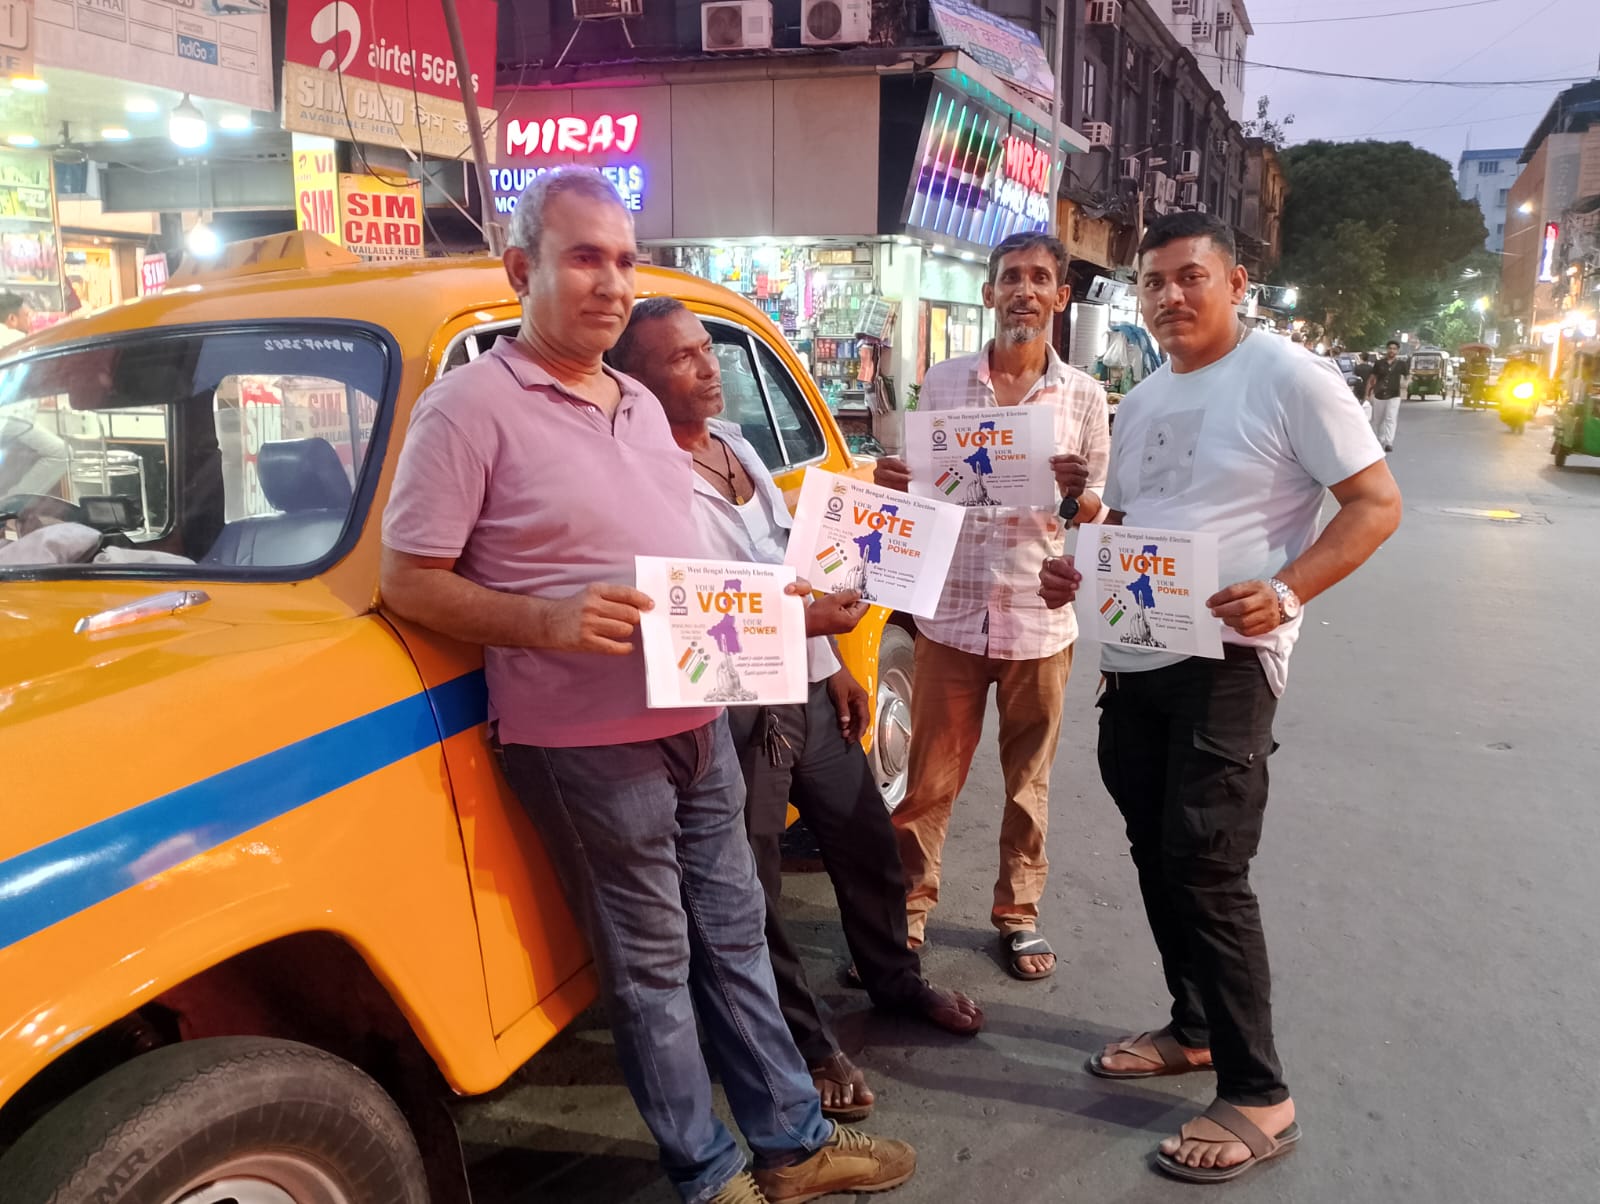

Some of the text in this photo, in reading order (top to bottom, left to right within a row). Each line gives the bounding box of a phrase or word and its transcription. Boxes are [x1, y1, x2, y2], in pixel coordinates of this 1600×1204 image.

[179, 40, 207, 60] IndiGo
[368, 38, 479, 93] airtel 5GPs
[299, 76, 348, 114] SIM
[354, 89, 404, 125] CARD
[300, 110, 368, 130] AVAILABLE
[507, 114, 638, 156] MIRAJ
[489, 168, 546, 191] TOUR
[300, 190, 335, 235] SIM
[347, 193, 415, 219] SIM
[345, 220, 421, 246] CARD
[346, 245, 420, 257] AVAILABLE HERE
[143, 262, 166, 286] SIM
[308, 392, 341, 428] SIM
[955, 429, 1014, 448] VOTE
[995, 453, 1027, 461] POWER
[851, 484, 864, 493] West
[865, 489, 885, 499] Bengal
[886, 495, 911, 505] Assembly
[913, 501, 936, 511] Election
[853, 506, 915, 538] VOTE
[887, 544, 921, 558] POWER
[687, 566, 702, 574] West
[703, 567, 723, 576] Bengal
[724, 568, 752, 577] Assembly
[752, 569, 775, 577] Election
[1119, 553, 1176, 577] VOTE
[696, 591, 763, 614] VOTE
[1157, 586, 1190, 597] POWER
[743, 626, 778, 635] POWER
